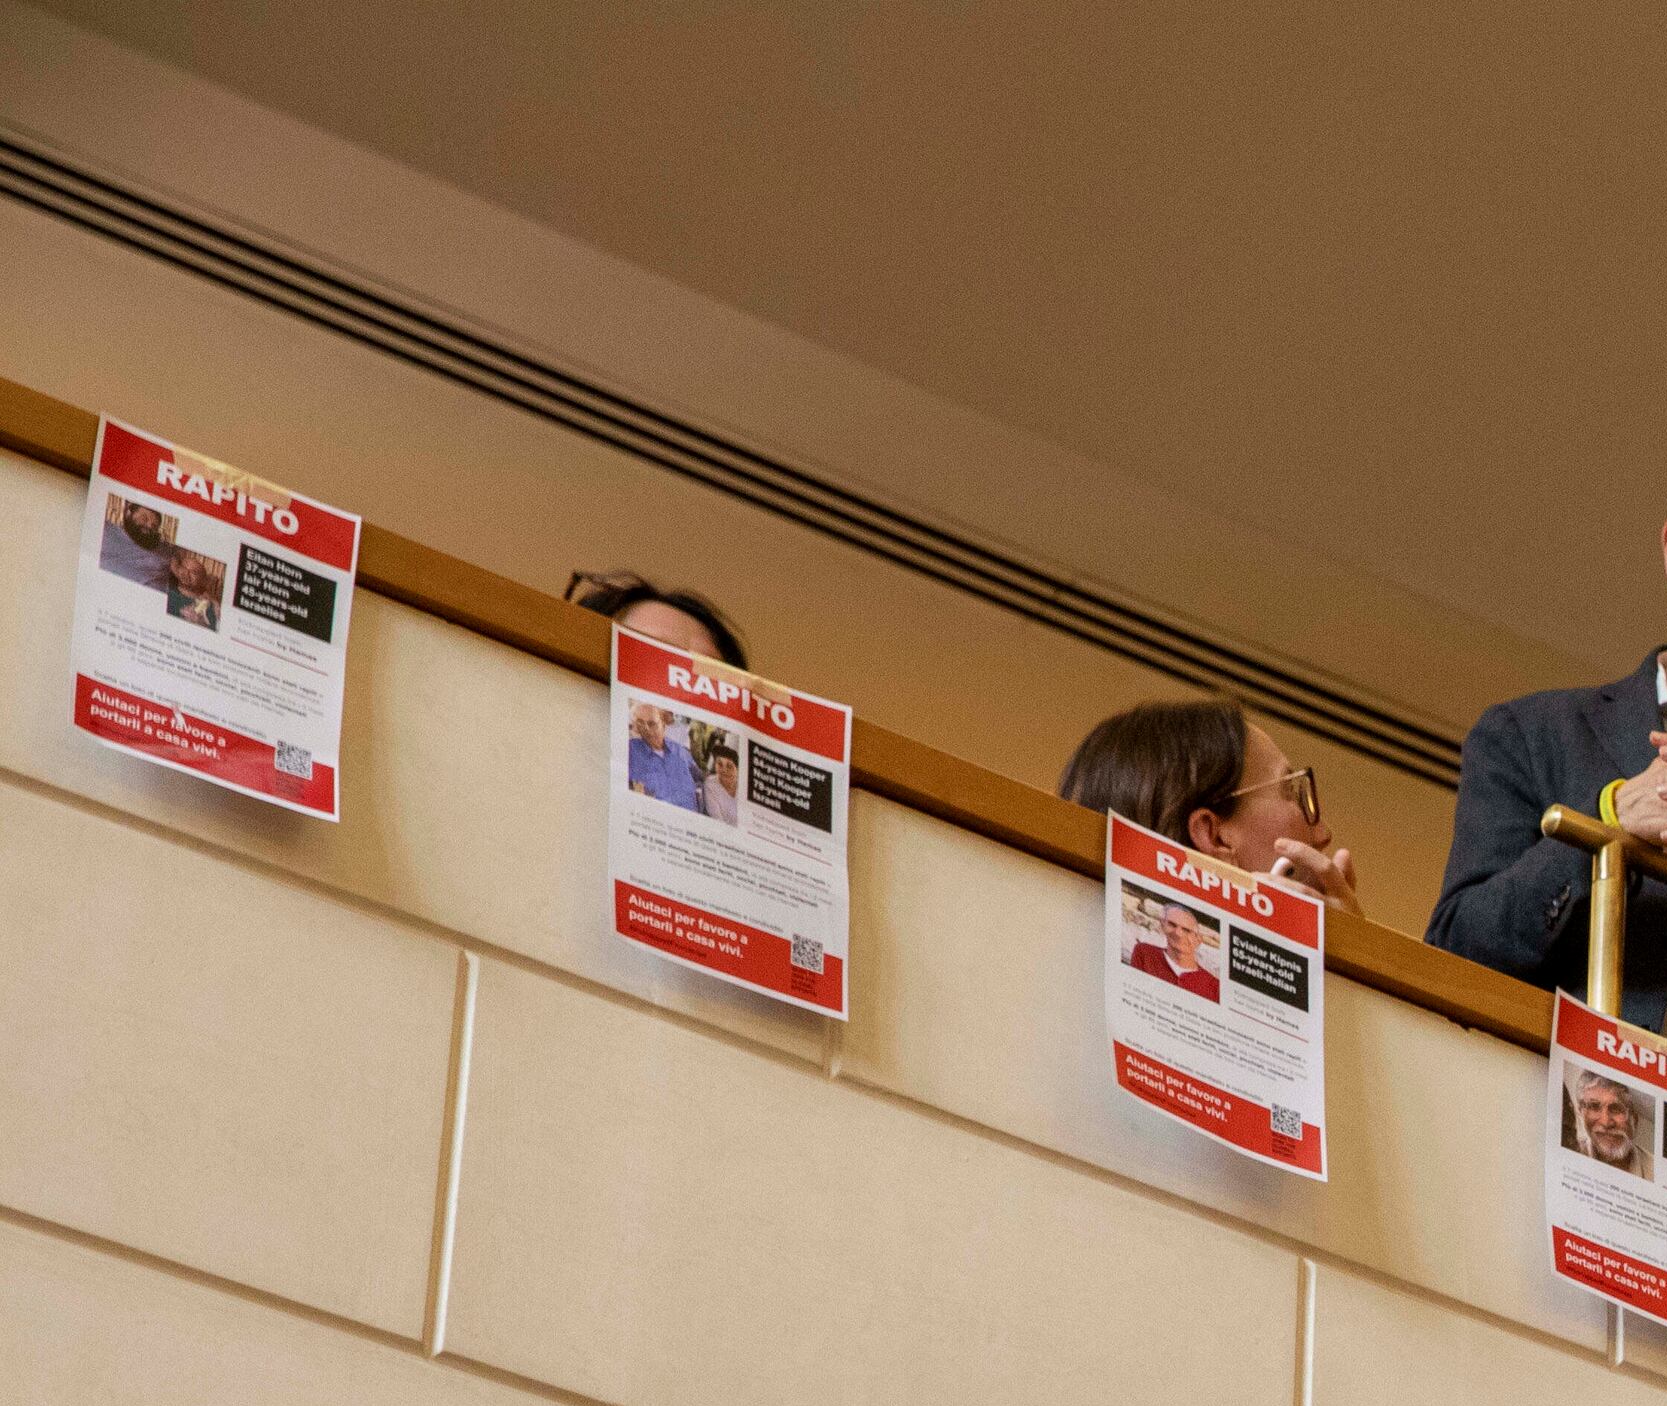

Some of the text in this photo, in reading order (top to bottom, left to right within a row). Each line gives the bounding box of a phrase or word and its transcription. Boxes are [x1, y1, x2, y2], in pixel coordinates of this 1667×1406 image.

[157, 461, 298, 536] RAPITO
[263, 580, 290, 599] Horn
[276, 560, 302, 580] Horn
[91, 686, 140, 716] Aiutaci
[143, 708, 166, 727] per
[170, 717, 214, 743] favore
[217, 735, 225, 747] a
[668, 664, 796, 731] RAPITO
[90, 702, 140, 731] portarli
[144, 724, 152, 735] a
[156, 728, 188, 749] casa
[192, 740, 220, 760] vivi.
[1157, 851, 1274, 917] RAPITO
[628, 892, 747, 946] Aiutaci per favore a
[629, 908, 672, 934] portarli
[675, 925, 682, 937] a
[686, 929, 715, 949] casa
[718, 939, 743, 959] vivi.
[1232, 934, 1301, 976] Eviatar Kipnis
[1232, 946, 1293, 984] 65-years-old
[1232, 957, 1296, 994] Israeli-Italian
[1125, 1053, 1163, 1080] Aiutaci
[1165, 1073, 1183, 1091] per
[1186, 1081, 1221, 1106] favore
[1223, 1099, 1231, 1111] a
[1126, 1067, 1164, 1093] portarli
[1167, 1086, 1174, 1098] a
[1176, 1091, 1202, 1111] casa
[1204, 1103, 1227, 1122] vivi.
[1564, 1237, 1601, 1262] Aiutaci
[1602, 1254, 1621, 1271] per
[1622, 1261, 1656, 1284] favore
[1658, 1277, 1665, 1288] a
[1565, 1251, 1602, 1275] portarli
[1604, 1268, 1611, 1278] a
[1613, 1272, 1638, 1290] casa
[1640, 1282, 1662, 1300] vivi.
